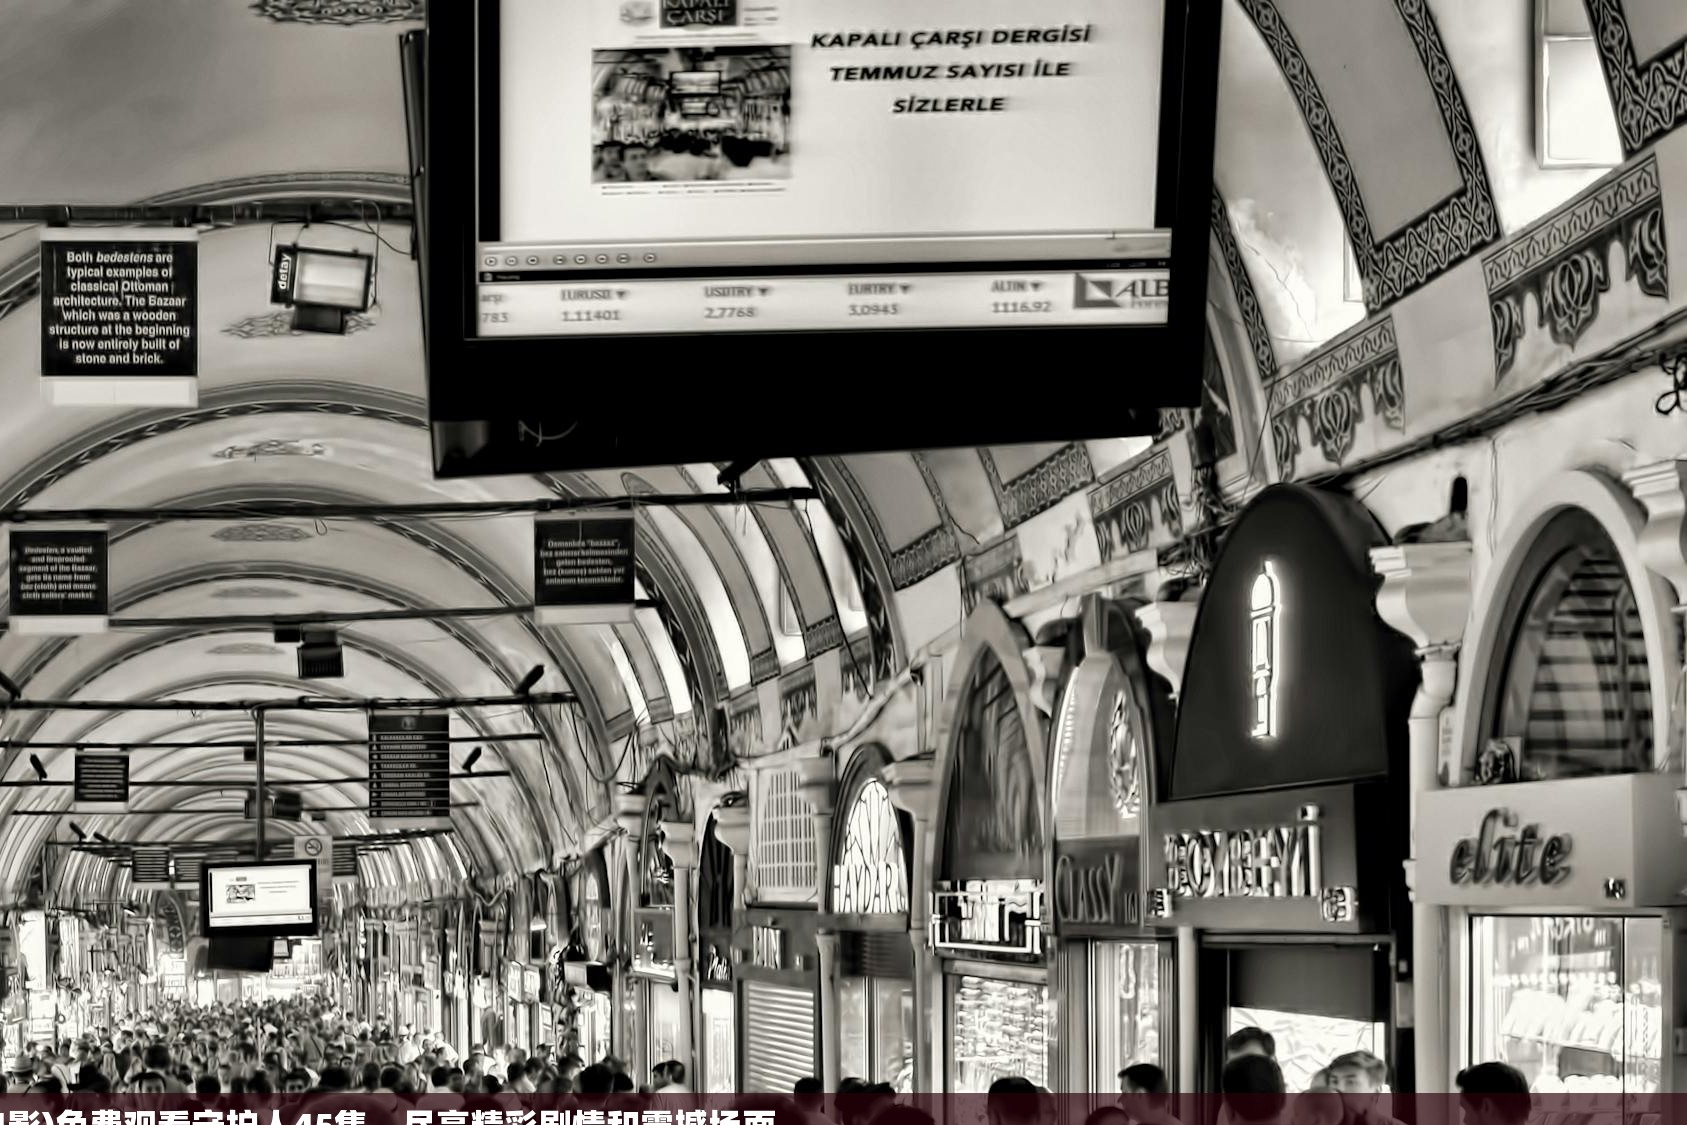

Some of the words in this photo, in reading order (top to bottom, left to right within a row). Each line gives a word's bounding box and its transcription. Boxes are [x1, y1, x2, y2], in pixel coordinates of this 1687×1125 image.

[811, 32, 901, 48] KAPALI
[910, 30, 983, 50] ÇARŞI
[991, 24, 1093, 44] DERGİSİ
[830, 65, 939, 81] TEMMUZ
[945, 62, 1024, 79] SAYISI
[1033, 58, 1072, 77] İLE
[892, 95, 1006, 113] SİZLERLE
[66, 251, 93, 263] Both
[96, 251, 154, 263] bedestens
[155, 253, 174, 263] are
[66, 265, 104, 279] typical
[106, 266, 159, 278] examples
[161, 266, 173, 278] of
[70, 281, 119, 292] classical
[121, 281, 169, 292] Ottoman
[53, 295, 123, 306] architecture.
[124, 295, 146, 306] The
[148, 295, 187, 306] Bazaar
[62, 309, 96, 321] which
[98, 311, 120, 321] was
[123, 311, 130, 321] a
[132, 309, 176, 321] wooden
[49, 324, 99, 335] structure
[101, 324, 112, 335] at
[114, 324, 133, 335] the
[135, 324, 190, 337] beginning
[72, 340, 95, 350] now
[97, 338, 139, 352] entirely
[141, 338, 166, 350] built
[168, 338, 180, 350] of
[75, 353, 107, 364] stone
[109, 353, 130, 364] and
[132, 353, 164, 364] brick.
[1450, 807, 1573, 885] elite
